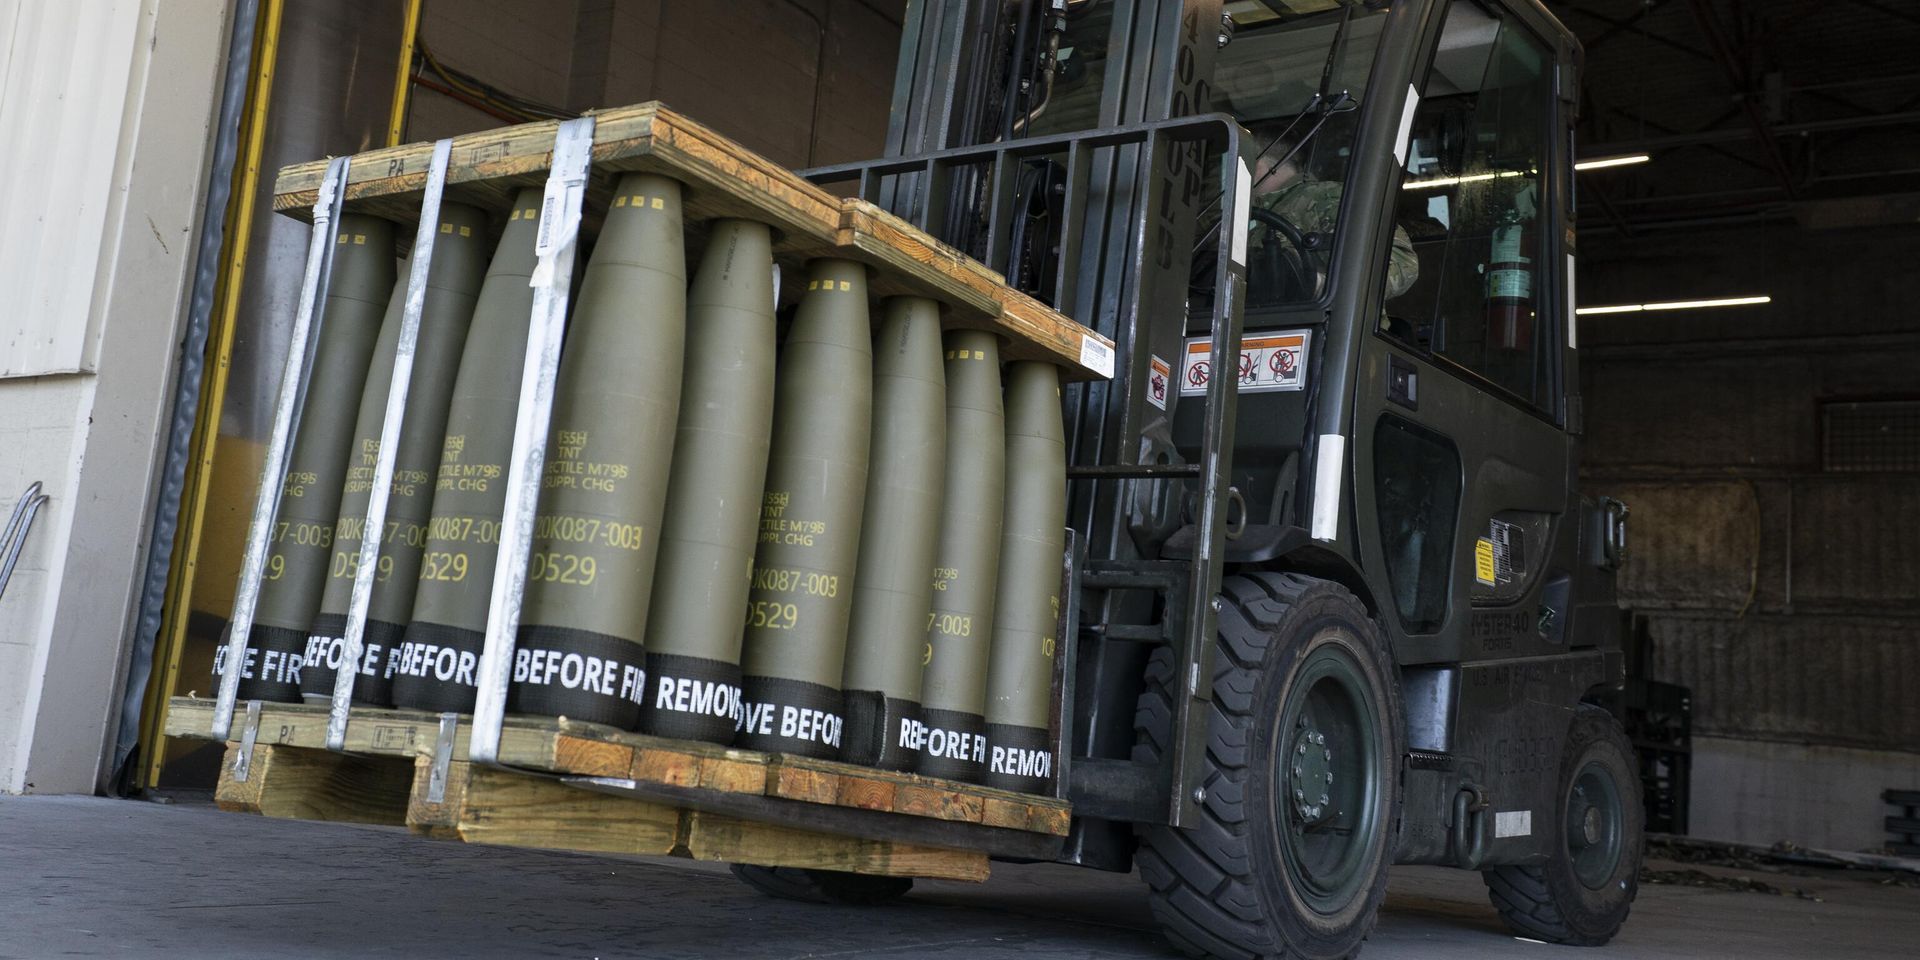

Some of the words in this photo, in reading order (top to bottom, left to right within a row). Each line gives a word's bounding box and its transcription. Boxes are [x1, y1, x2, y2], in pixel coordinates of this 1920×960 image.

[388, 158, 405, 176] PA
[362, 455, 379, 467] TN
[559, 447, 582, 460] TNT
[457, 479, 487, 492] CHG
[582, 477, 615, 493] CHG
[785, 533, 813, 547] CHG
[531, 552, 596, 586] D529
[513, 648, 618, 696] BEFORE
[279, 726, 295, 744] PA
